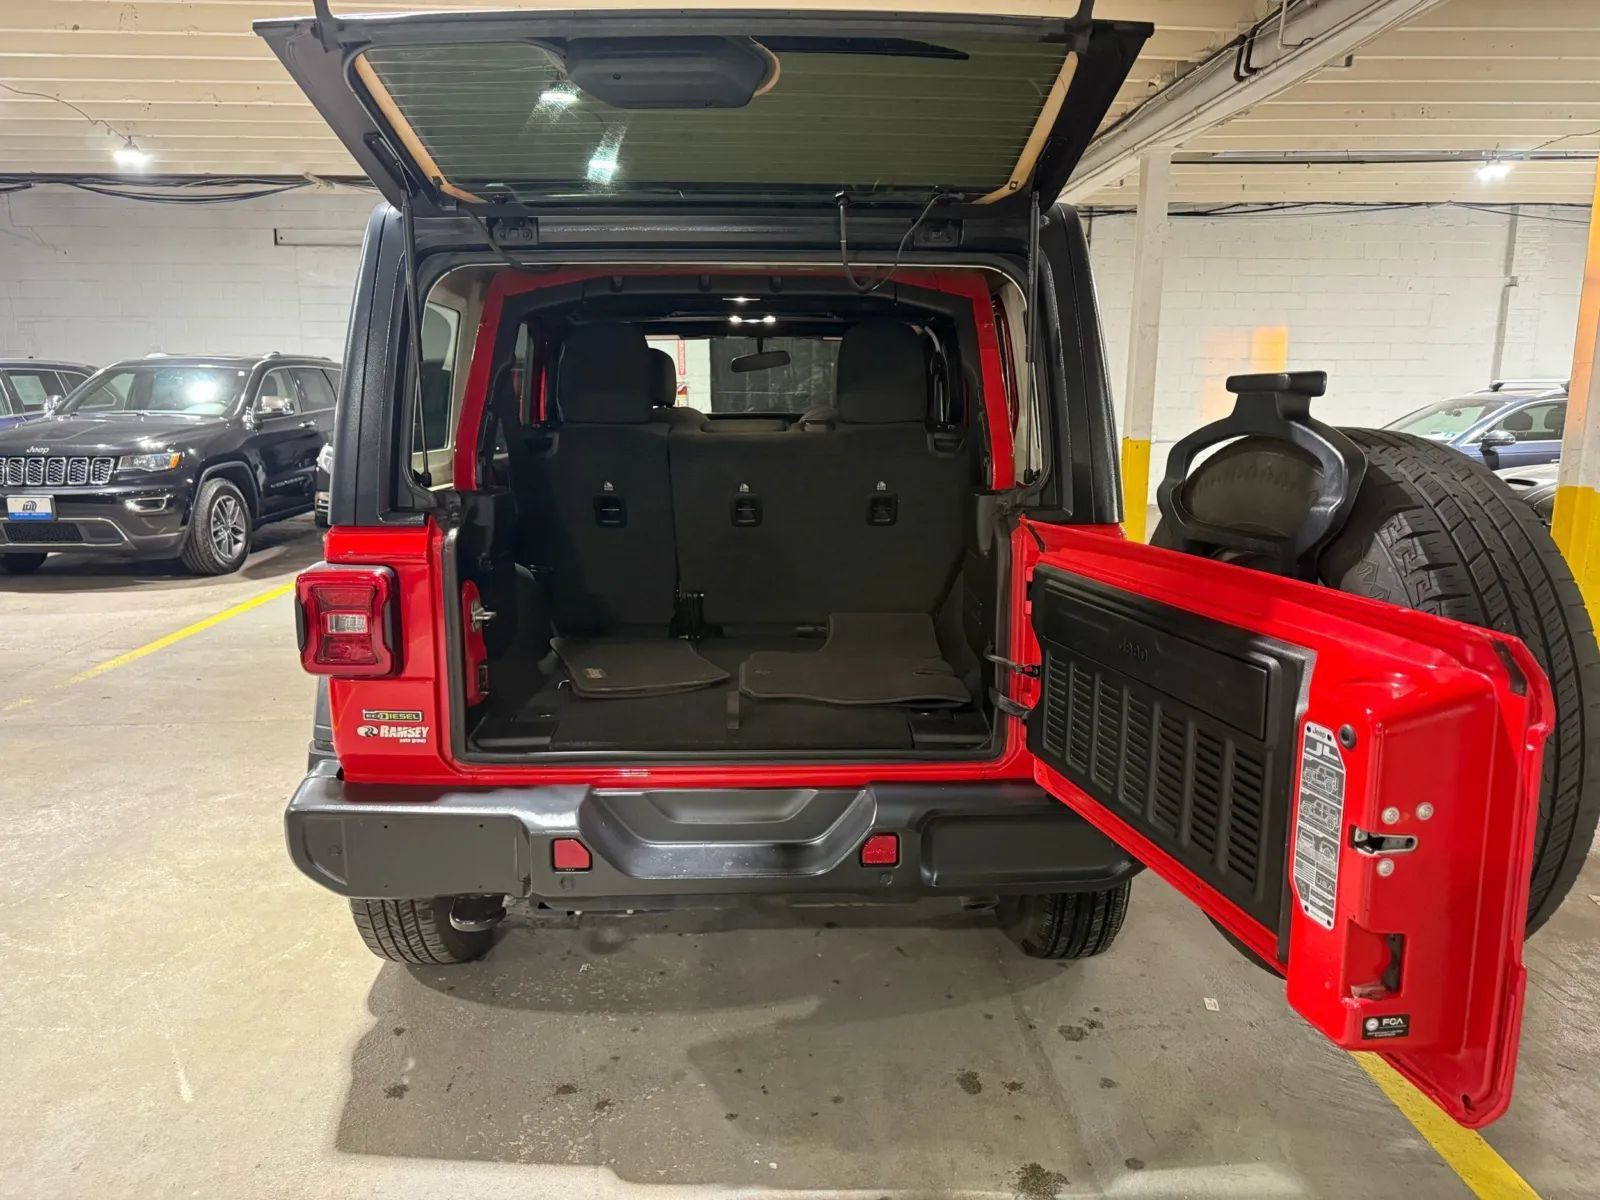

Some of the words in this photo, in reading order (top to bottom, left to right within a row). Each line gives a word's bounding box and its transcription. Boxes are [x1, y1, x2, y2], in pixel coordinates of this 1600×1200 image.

[26, 445, 50, 455] Jeep
[380, 725, 430, 738] RAMSEY
[1312, 727, 1326, 739] Jeep
[1305, 742, 1339, 762] JL
[1383, 1017, 1404, 1026] FCA
